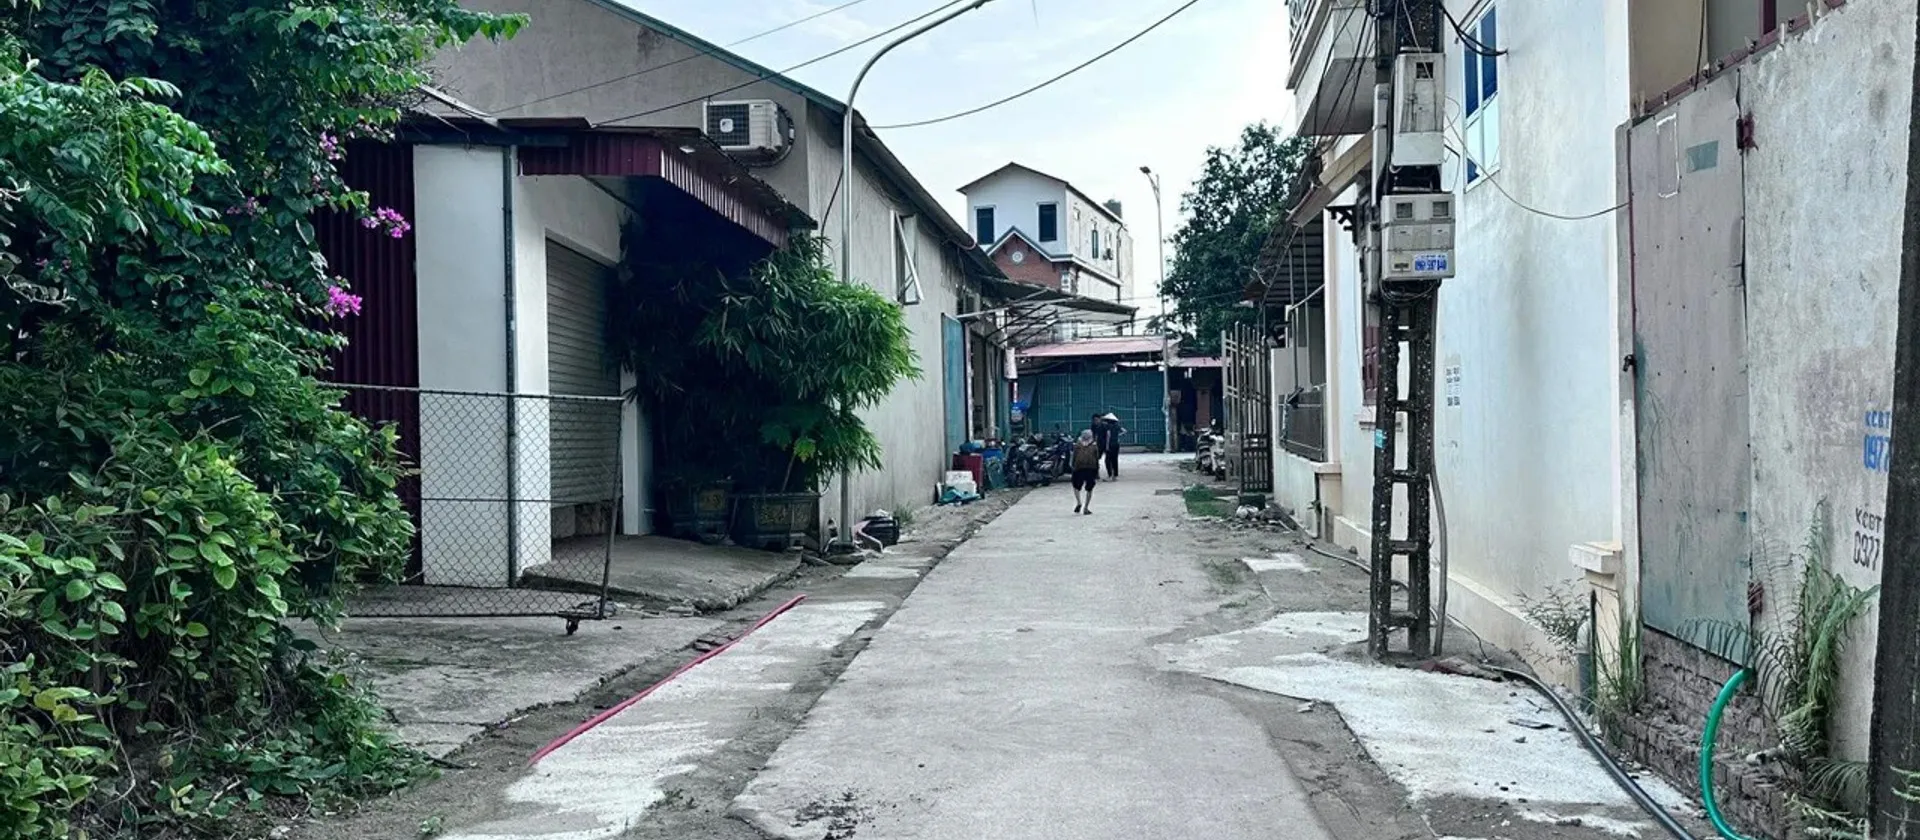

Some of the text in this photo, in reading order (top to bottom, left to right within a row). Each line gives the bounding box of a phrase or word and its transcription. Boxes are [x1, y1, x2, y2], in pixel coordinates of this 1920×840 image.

[1865, 410, 1890, 429] KCBT
[1864, 434, 1890, 473] 0977
[1855, 507, 1882, 533] KCBT
[1853, 530, 1880, 571] 0977
